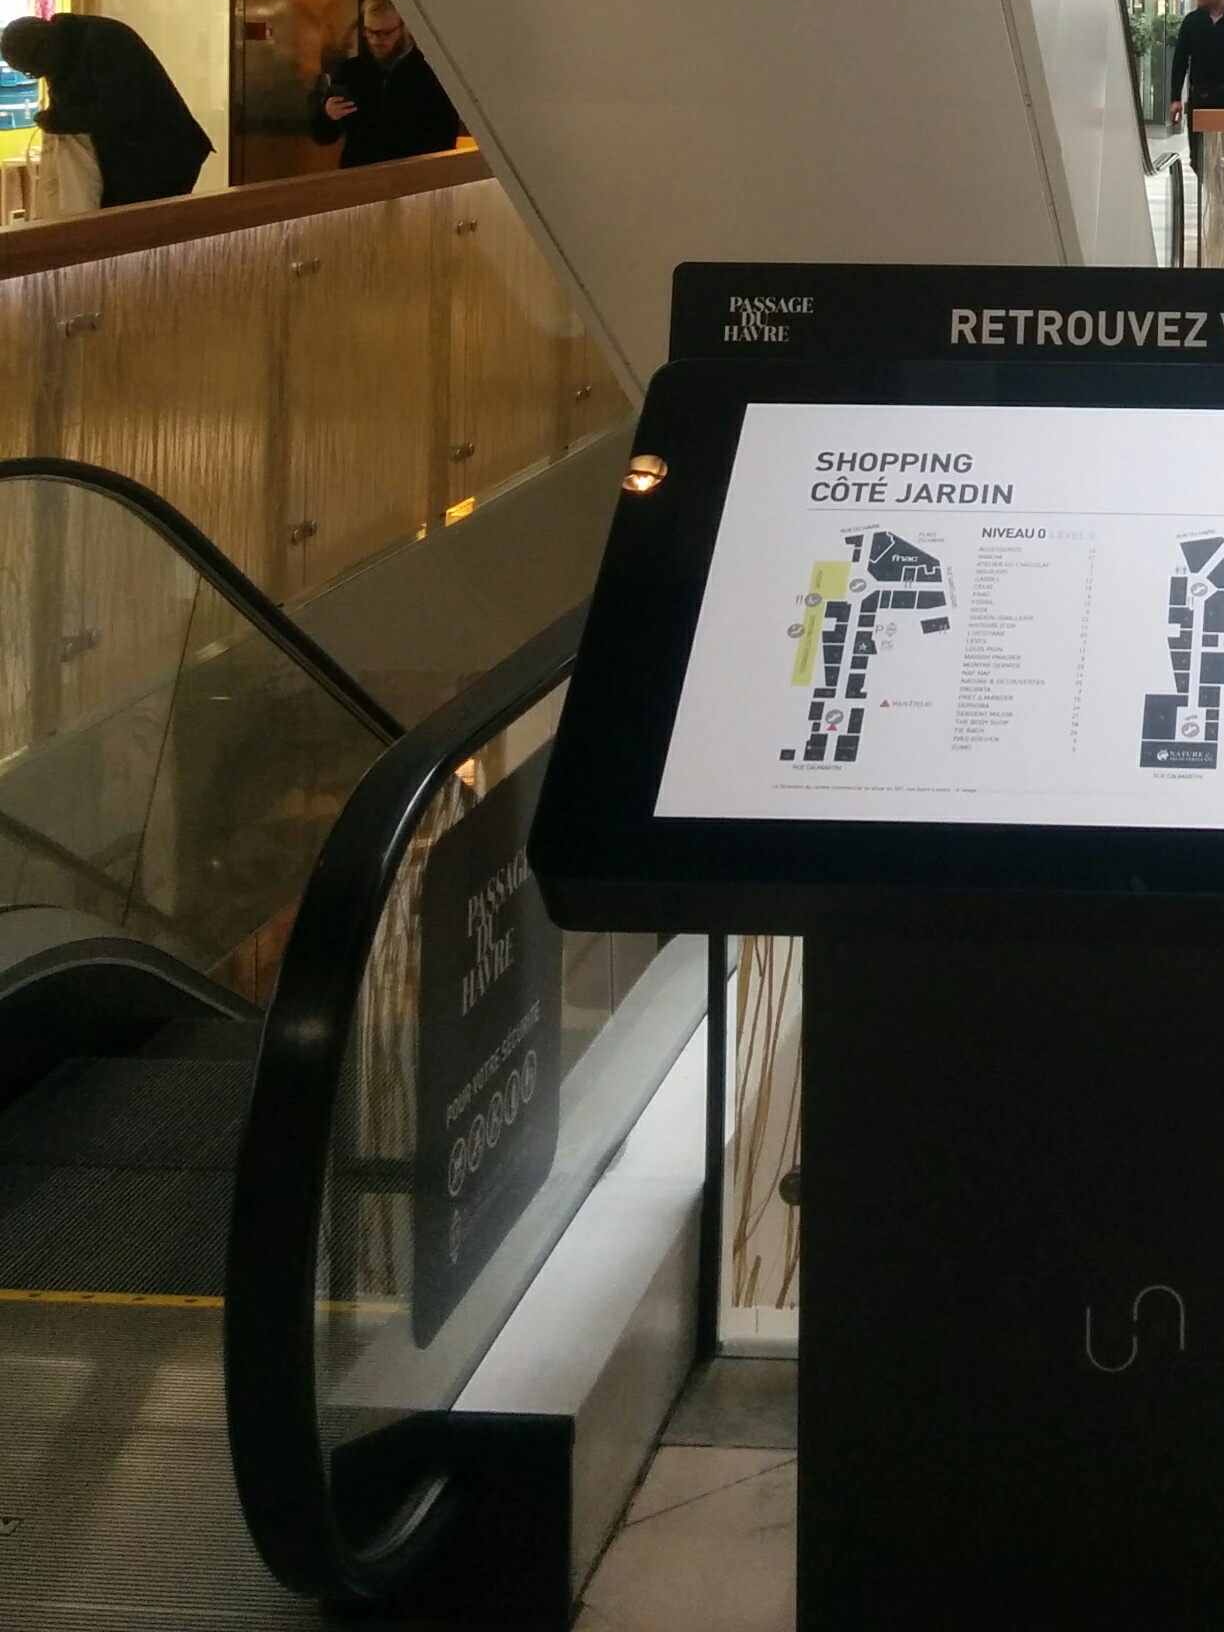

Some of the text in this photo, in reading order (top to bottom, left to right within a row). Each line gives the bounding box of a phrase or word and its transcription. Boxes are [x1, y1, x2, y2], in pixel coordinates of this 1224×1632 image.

[729, 296, 814, 313] PASSAGE
[741, 311, 768, 327] DU
[724, 325, 789, 342] HAVRE
[950, 308, 1208, 348] RETROUVEZ
[815, 451, 973, 473] SHOPPING
[811, 475, 1014, 505] CÔTÉ JARDIN
[981, 527, 1035, 539] NIVEAU
[1038, 528, 1047, 539] 0
[1050, 531, 1086, 540] LEVEL
[892, 554, 918, 562] fnac
